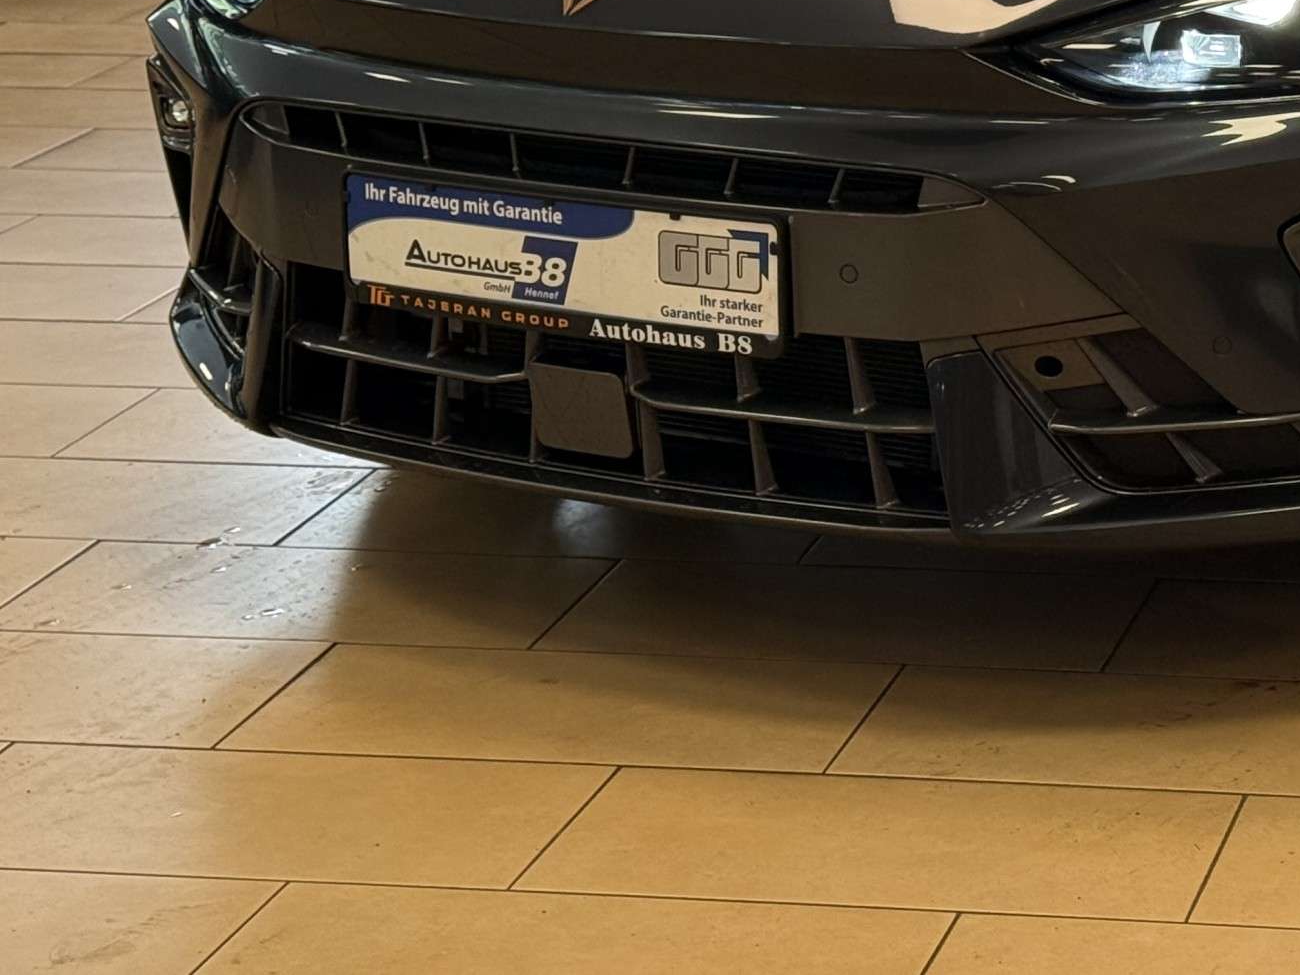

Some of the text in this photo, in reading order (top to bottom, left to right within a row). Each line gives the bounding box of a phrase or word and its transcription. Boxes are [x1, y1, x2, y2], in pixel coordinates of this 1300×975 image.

[364, 182, 564, 225] Ihr Fahrzeug mit Garantie
[658, 228, 769, 294] GGG
[483, 281, 511, 294] GmbH
[524, 286, 560, 301] Hennef
[699, 294, 763, 313] Ihr starker
[501, 309, 570, 329] GROUP
[660, 305, 764, 329] Garantie-Partner
[589, 318, 753, 355] Autohaus B8
